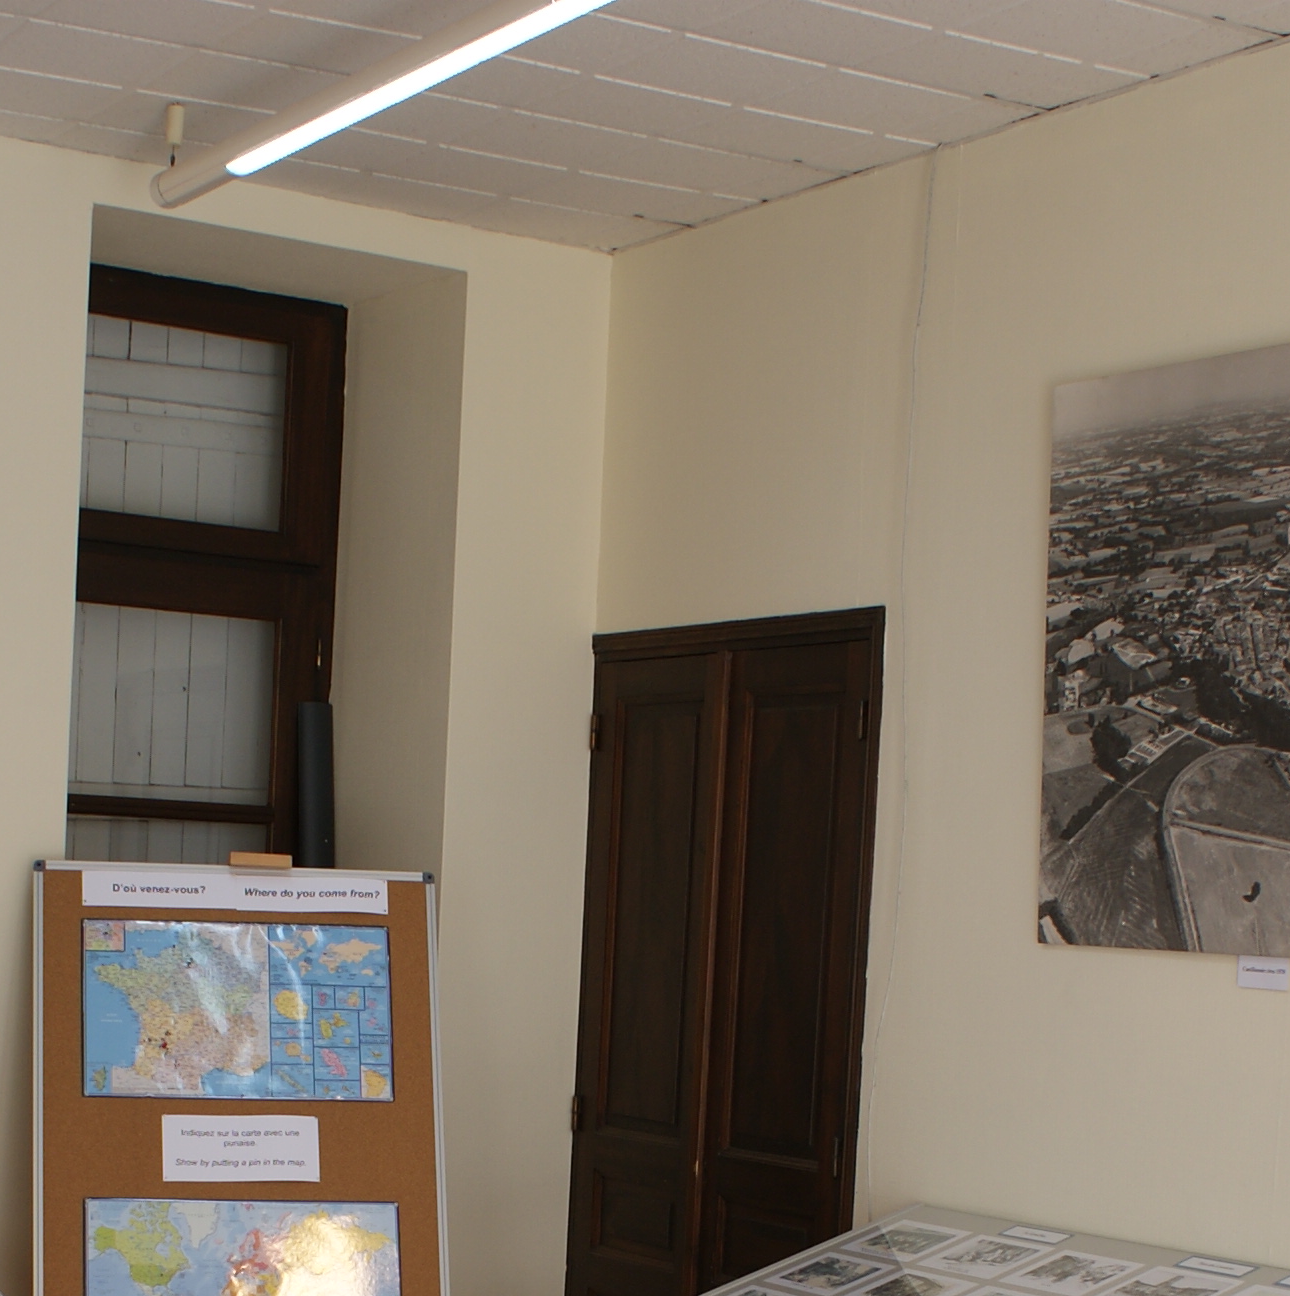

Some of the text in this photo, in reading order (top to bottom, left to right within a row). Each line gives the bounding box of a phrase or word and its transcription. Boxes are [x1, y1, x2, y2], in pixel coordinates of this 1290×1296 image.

[112, 884, 206, 894] D'où venez-vous?
[244, 888, 380, 900] Where do you come from?
[181, 1129, 214, 1138] Indiquez
[231, 1129, 239, 1137] la
[175, 1158, 198, 1166] Show
[199, 1159, 210, 1167] by
[211, 1159, 239, 1168] putting
[248, 1159, 261, 1167] pin
